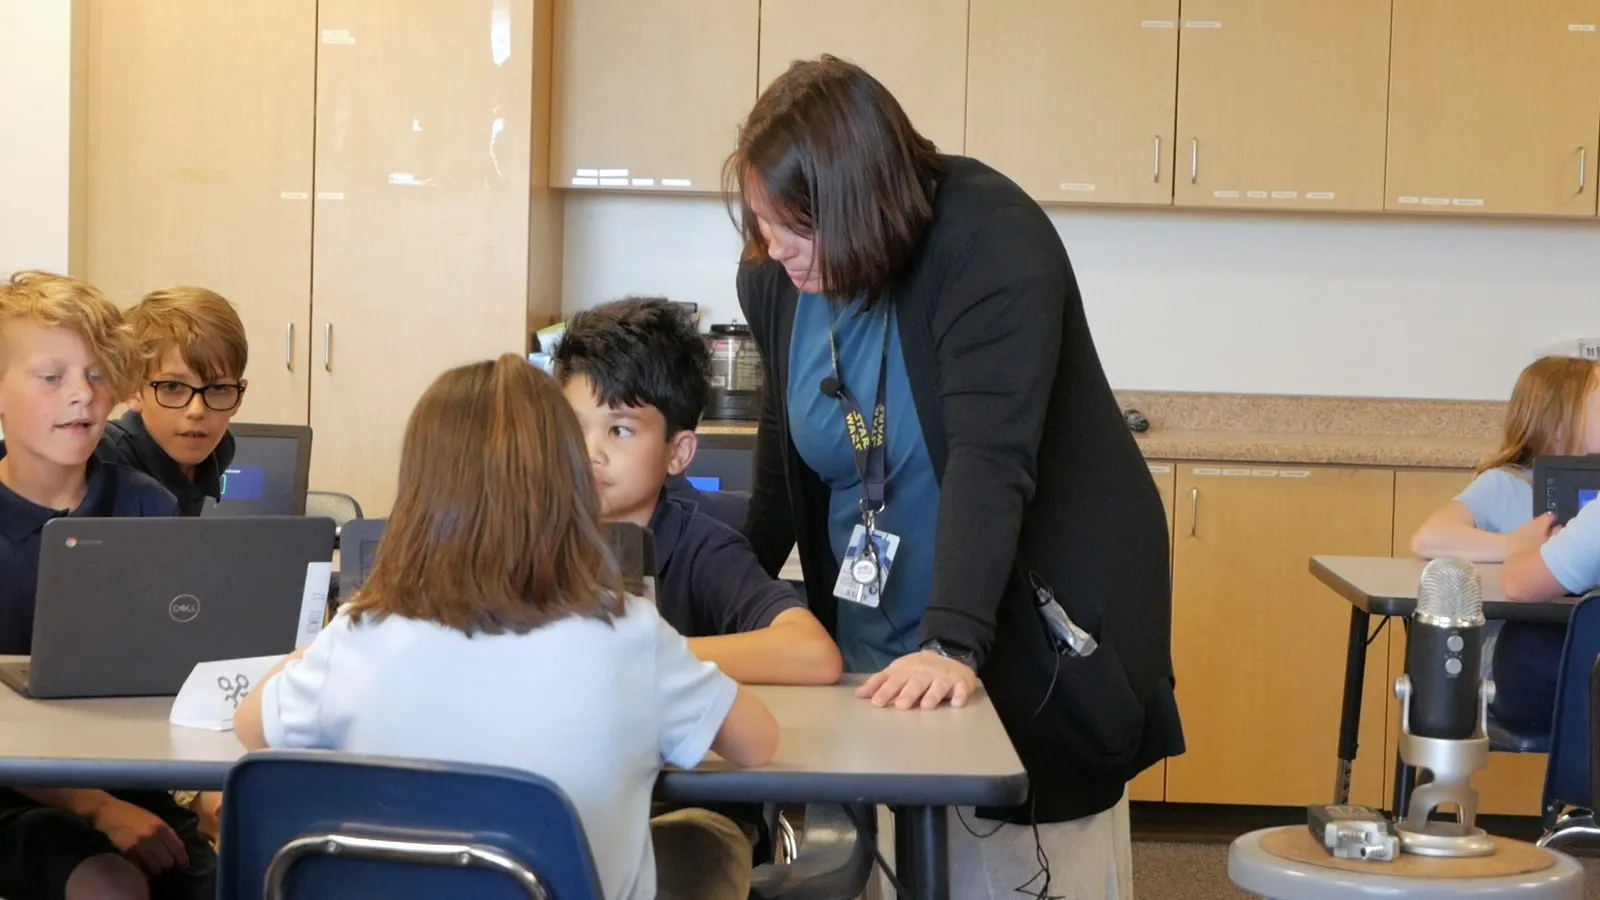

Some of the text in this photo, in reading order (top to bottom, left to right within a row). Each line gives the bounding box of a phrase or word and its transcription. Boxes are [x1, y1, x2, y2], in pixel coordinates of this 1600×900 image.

[846, 412, 863, 451] WARS
[853, 410, 870, 450] STAR
[173, 604, 197, 613] DELL
